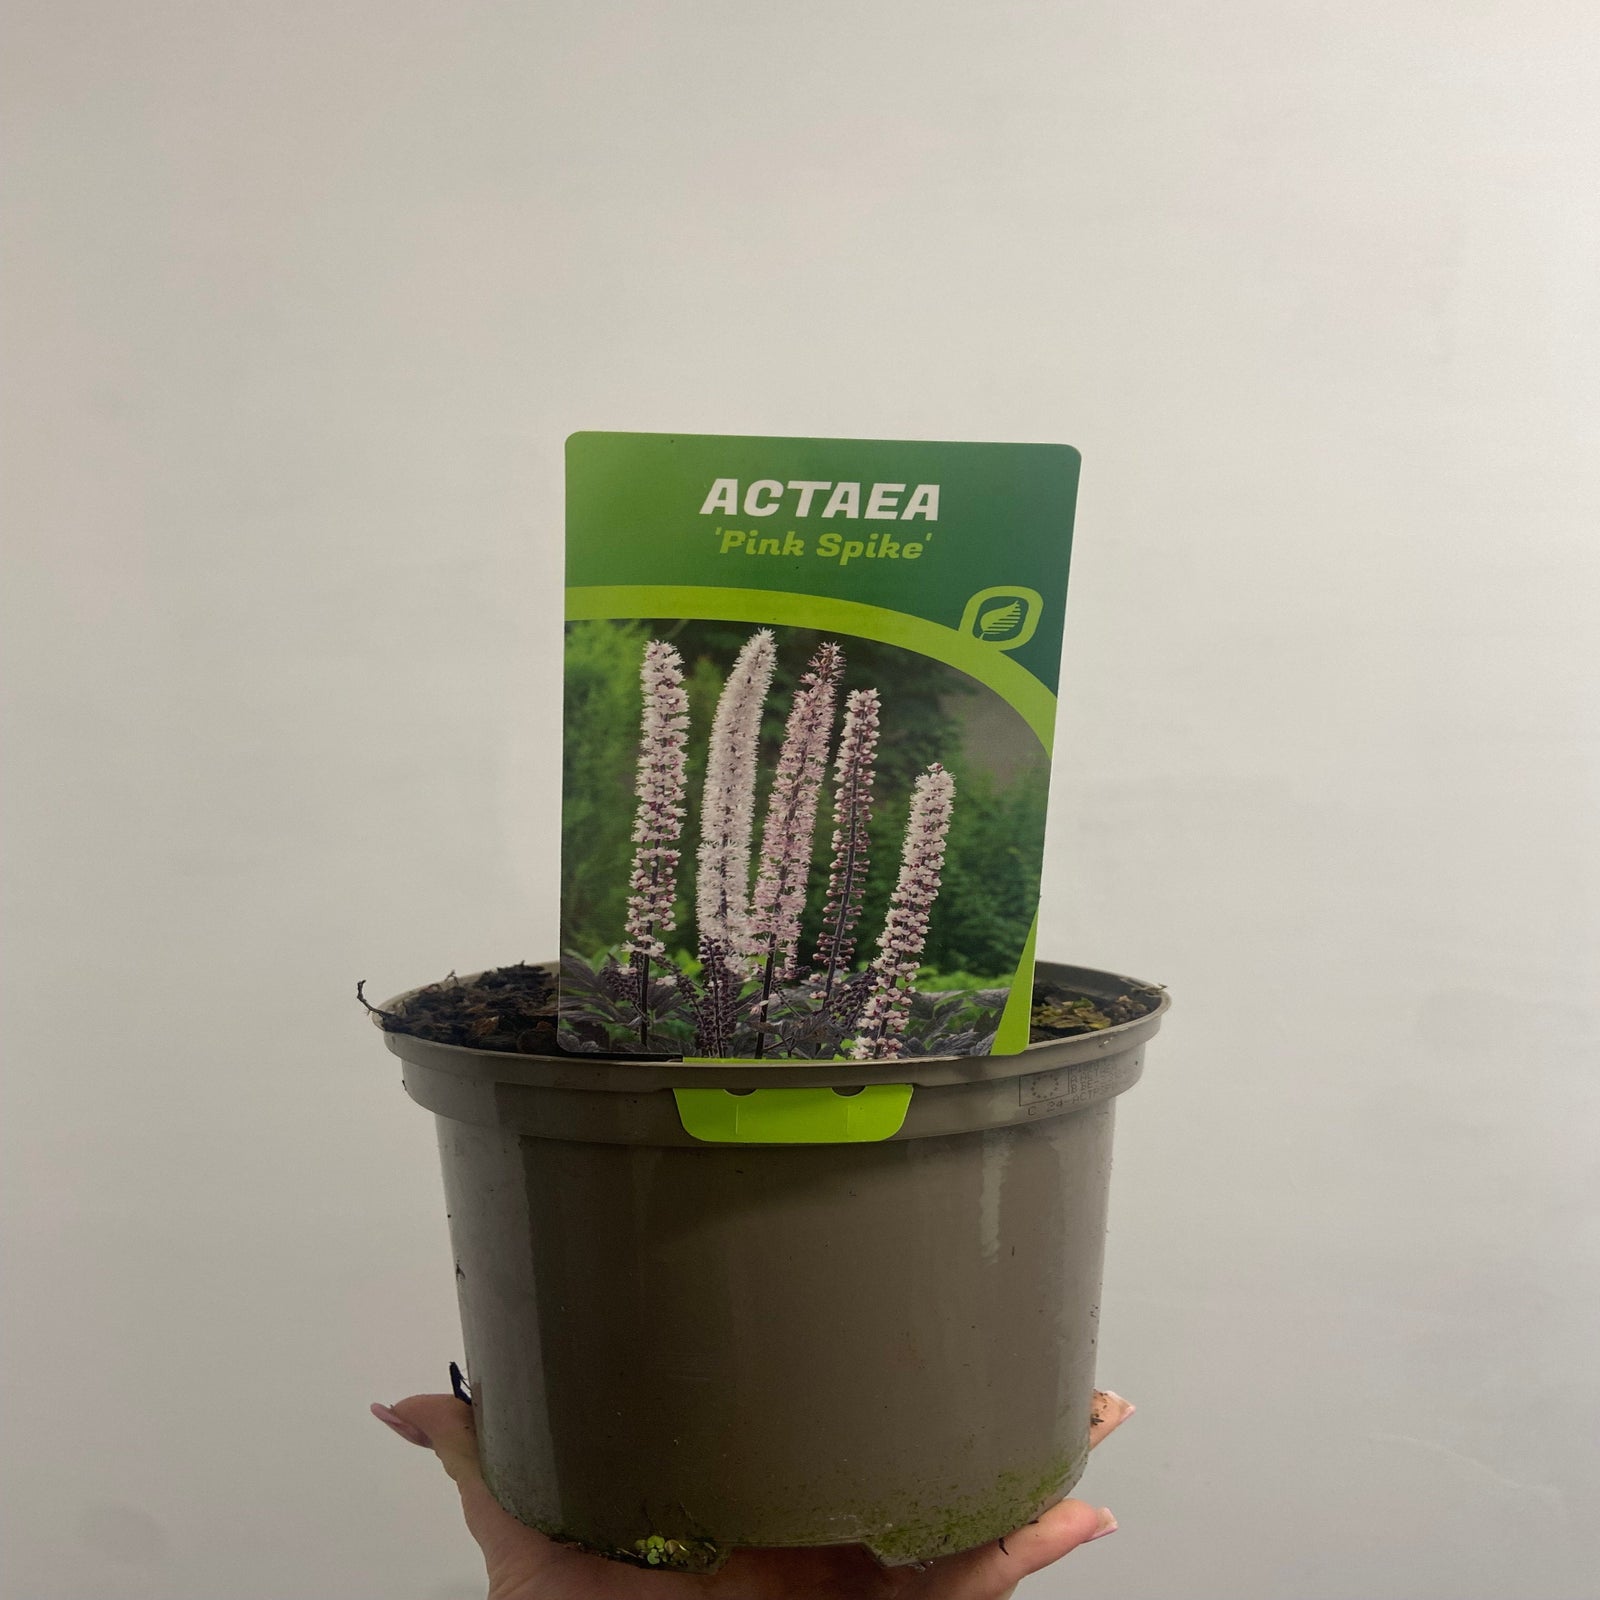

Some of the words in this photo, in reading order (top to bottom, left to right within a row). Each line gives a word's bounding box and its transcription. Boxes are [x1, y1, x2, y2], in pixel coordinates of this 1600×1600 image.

[699, 478, 940, 521] ACTAEA
[715, 527, 805, 557] 'Pink
[816, 533, 933, 566] Spike'
